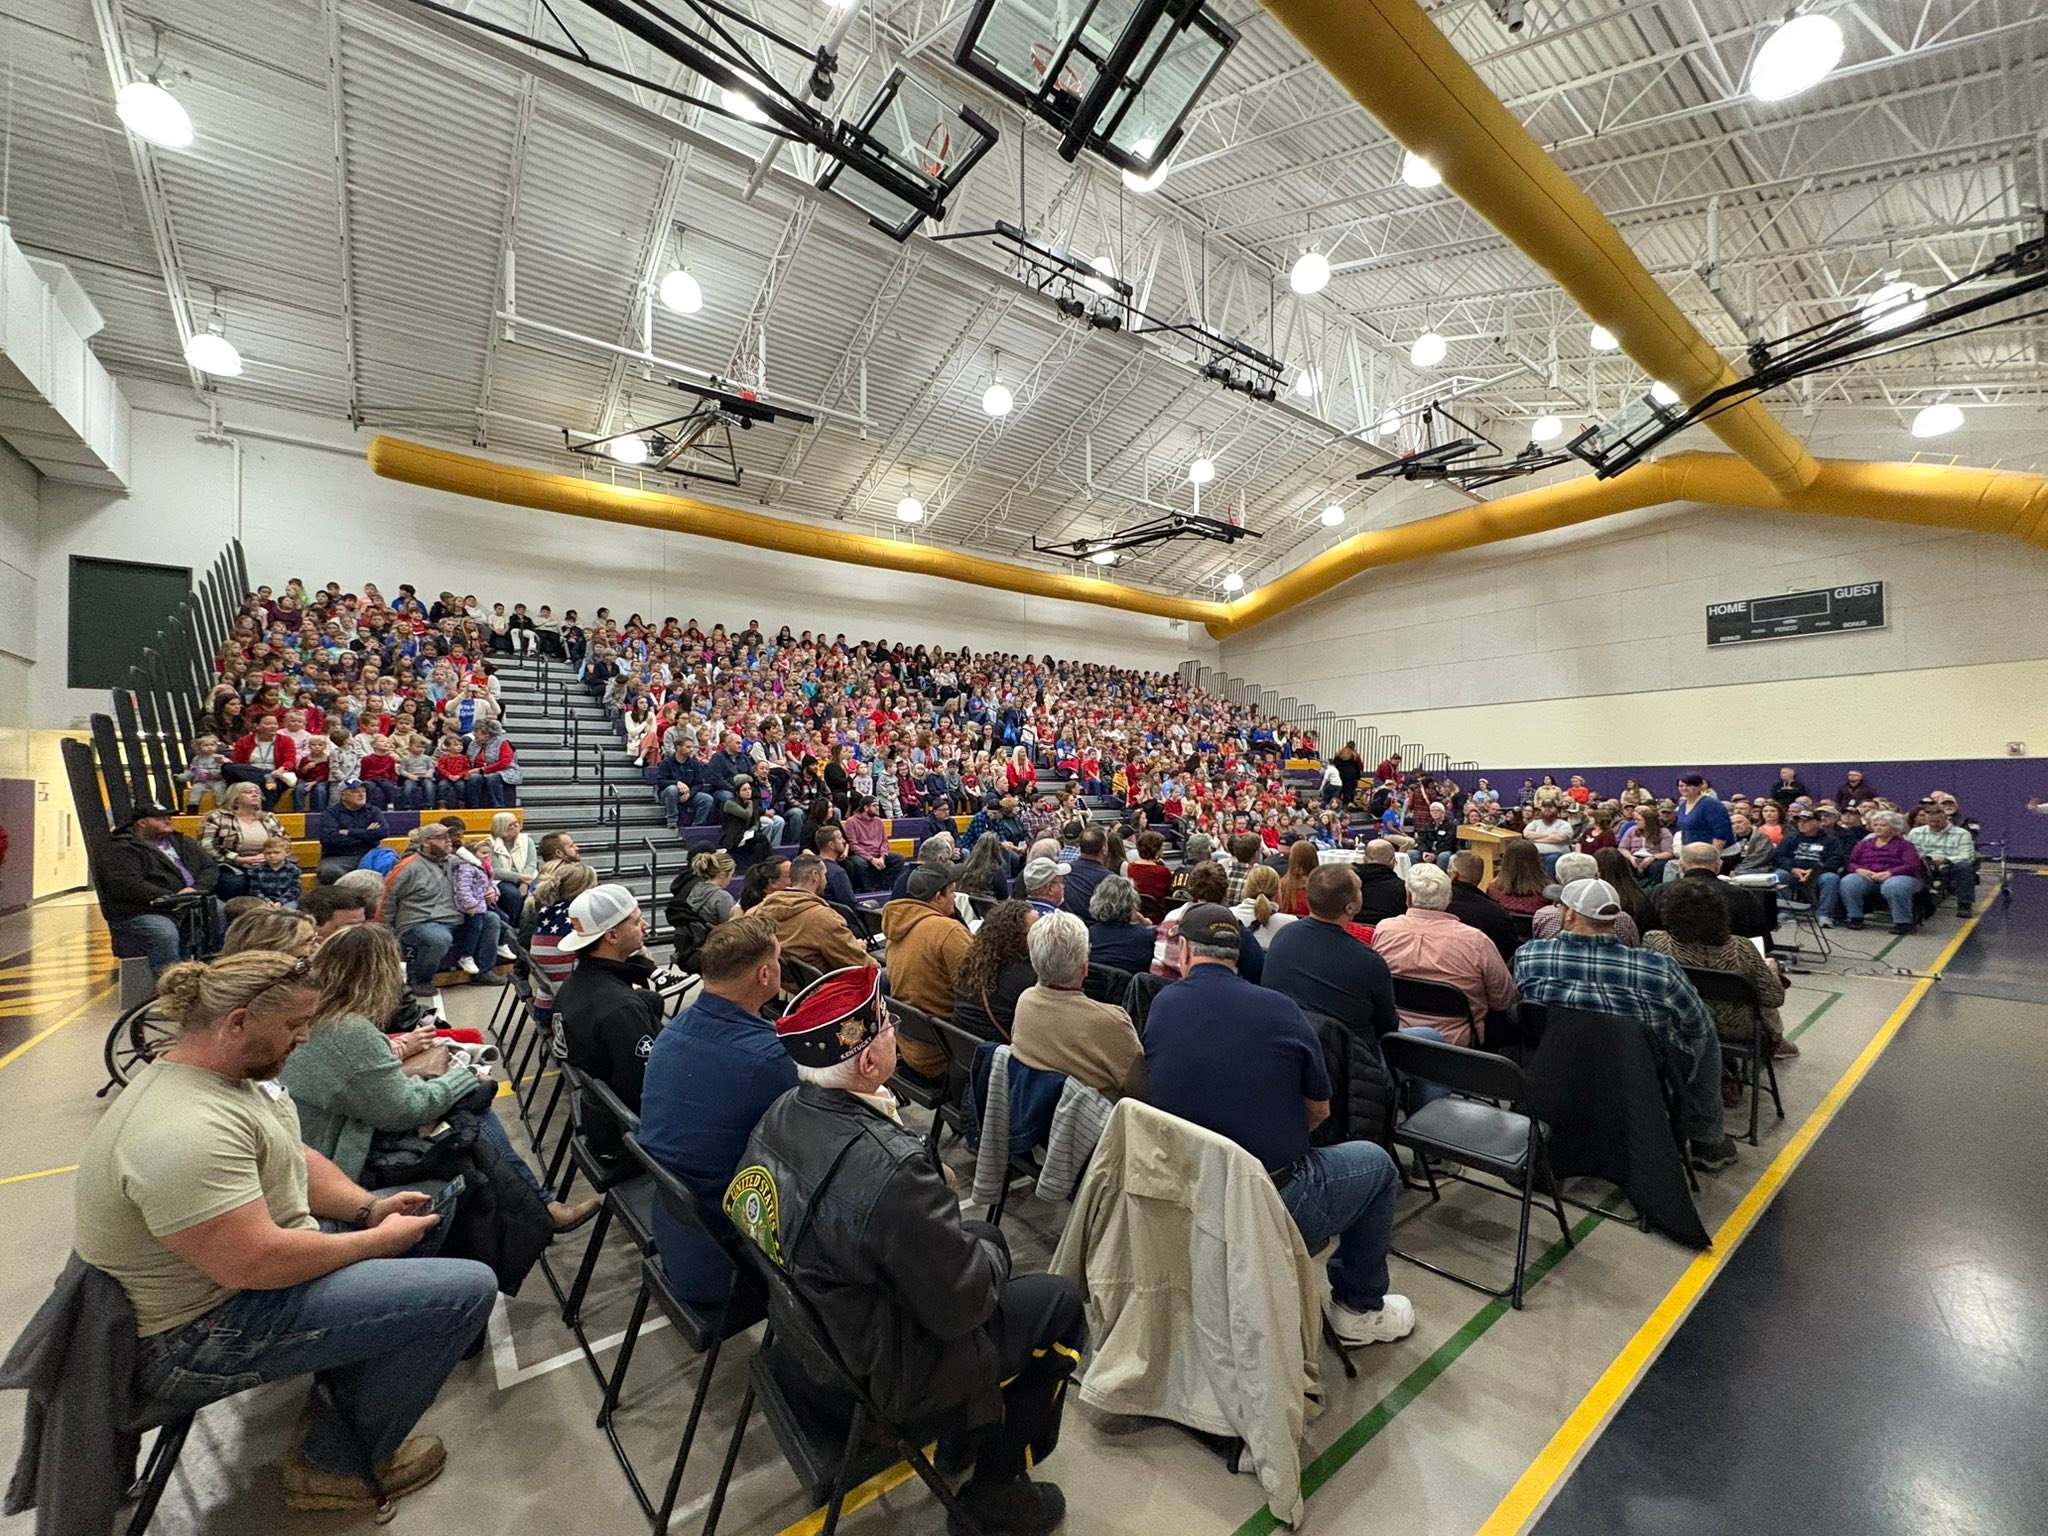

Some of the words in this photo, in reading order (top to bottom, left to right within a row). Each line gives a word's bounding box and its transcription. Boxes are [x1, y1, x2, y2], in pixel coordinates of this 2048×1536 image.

[1834, 583, 1880, 599] GUEST
[1708, 602, 1747, 616] HOME
[1842, 620, 1868, 628] BONUS
[840, 1036, 872, 1060] KENTUCKY
[730, 1174, 761, 1200] UNITED
